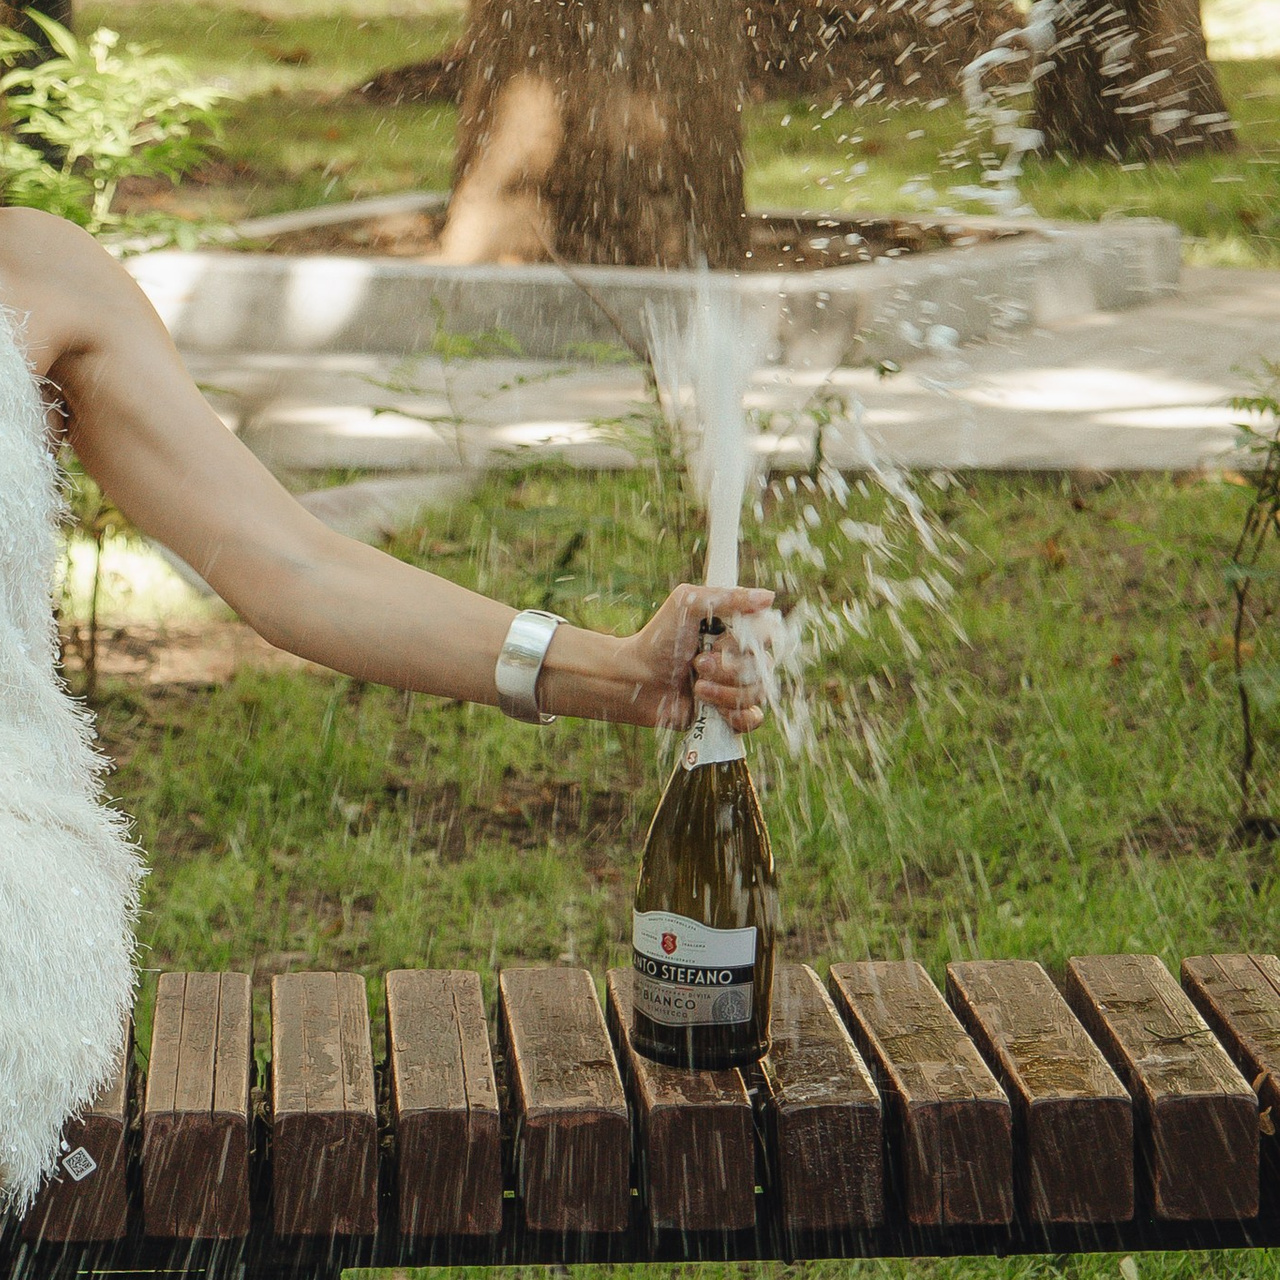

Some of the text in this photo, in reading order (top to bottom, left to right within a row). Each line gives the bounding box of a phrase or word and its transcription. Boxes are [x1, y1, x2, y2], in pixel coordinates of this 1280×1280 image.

[633, 953, 733, 984] ANTO STEFANO
[643, 989, 696, 1010] BIANCO
